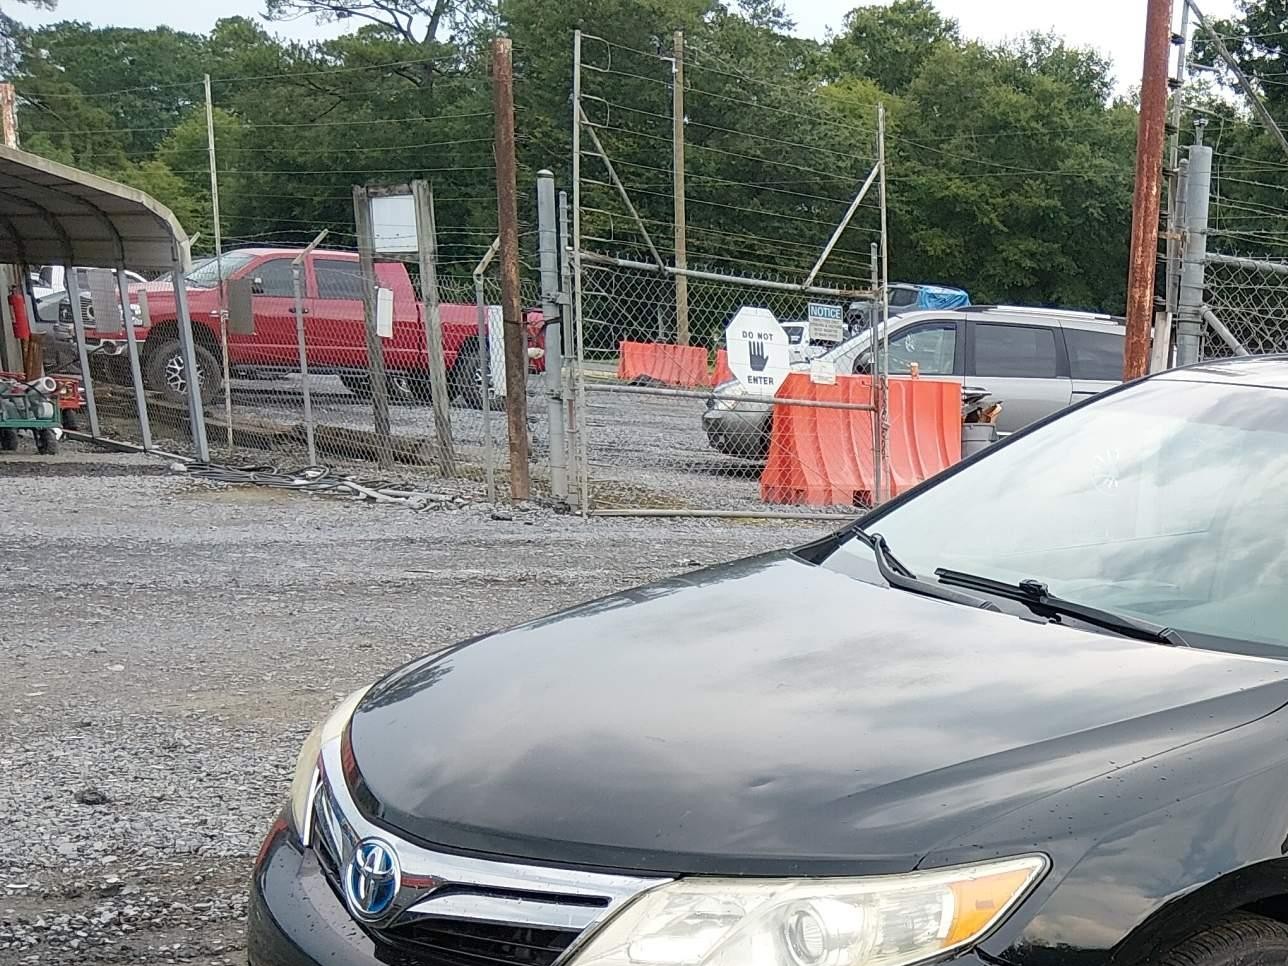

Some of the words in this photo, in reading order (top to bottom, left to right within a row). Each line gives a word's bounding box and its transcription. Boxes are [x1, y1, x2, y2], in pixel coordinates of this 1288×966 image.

[810, 305, 841, 319] NOTICE
[742, 331, 754, 339] DO
[757, 333, 774, 341] NOT
[747, 375, 774, 385] ENTER
